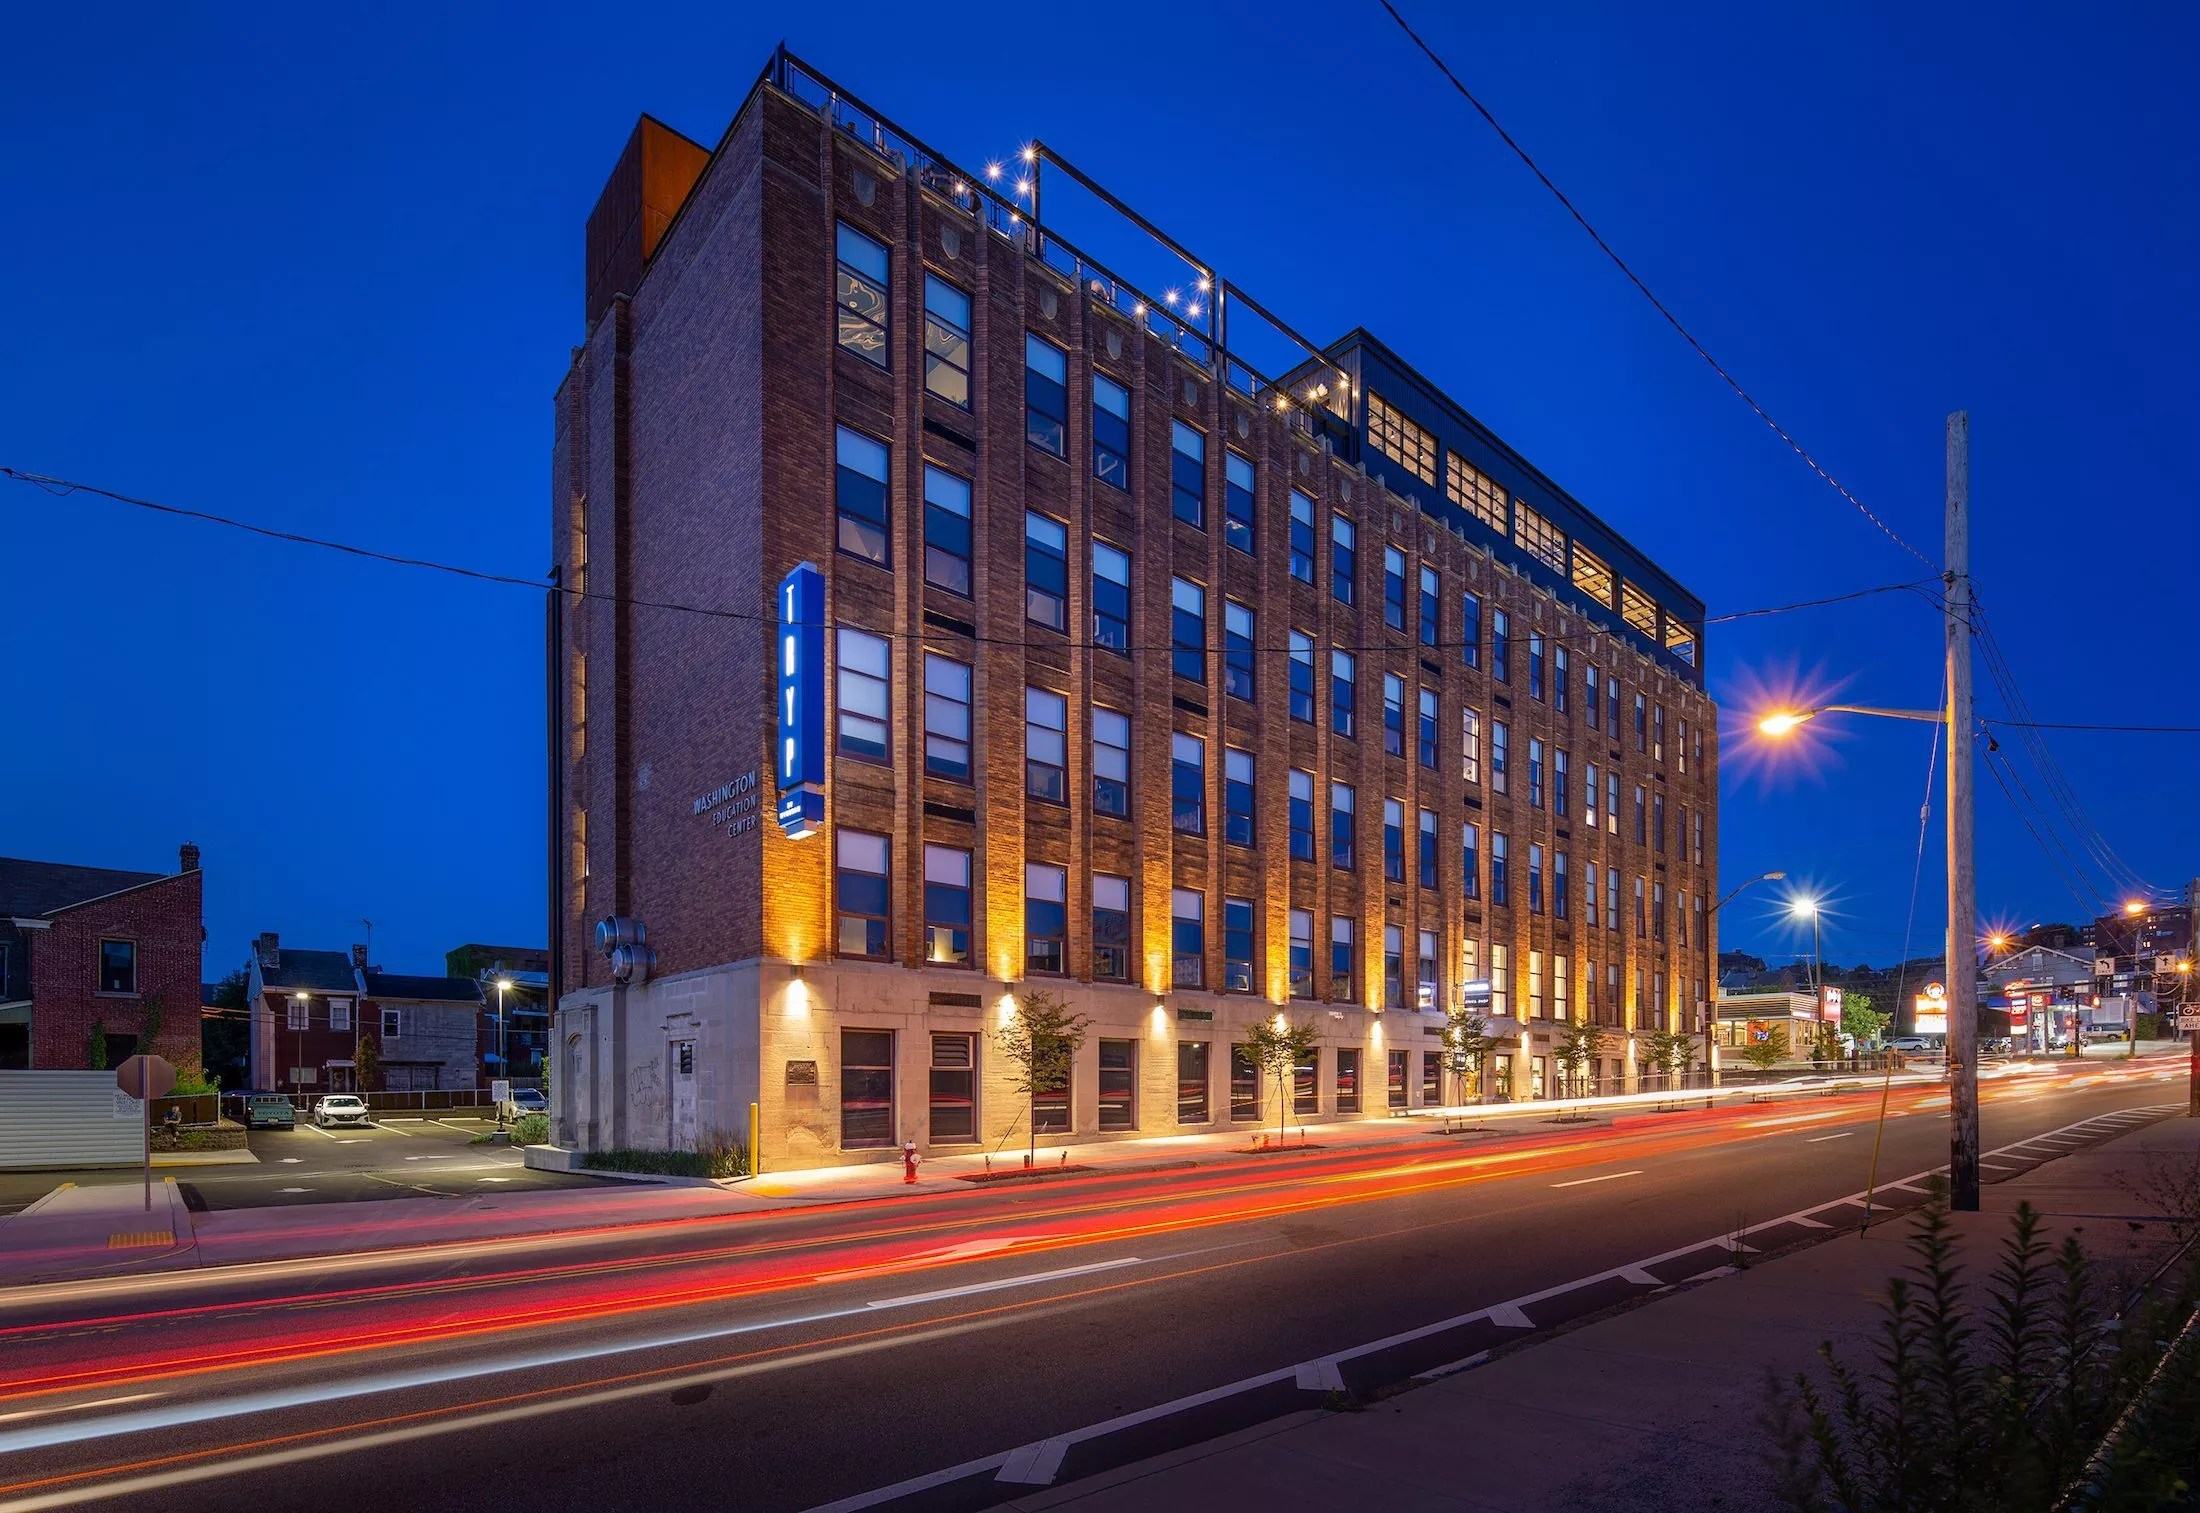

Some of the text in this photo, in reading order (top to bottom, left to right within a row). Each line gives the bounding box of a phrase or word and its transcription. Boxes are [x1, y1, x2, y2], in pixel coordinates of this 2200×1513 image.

[694, 771, 755, 815] WASHINGTON
[713, 795, 756, 826] EDUCATION
[728, 815, 756, 838] CENTER
